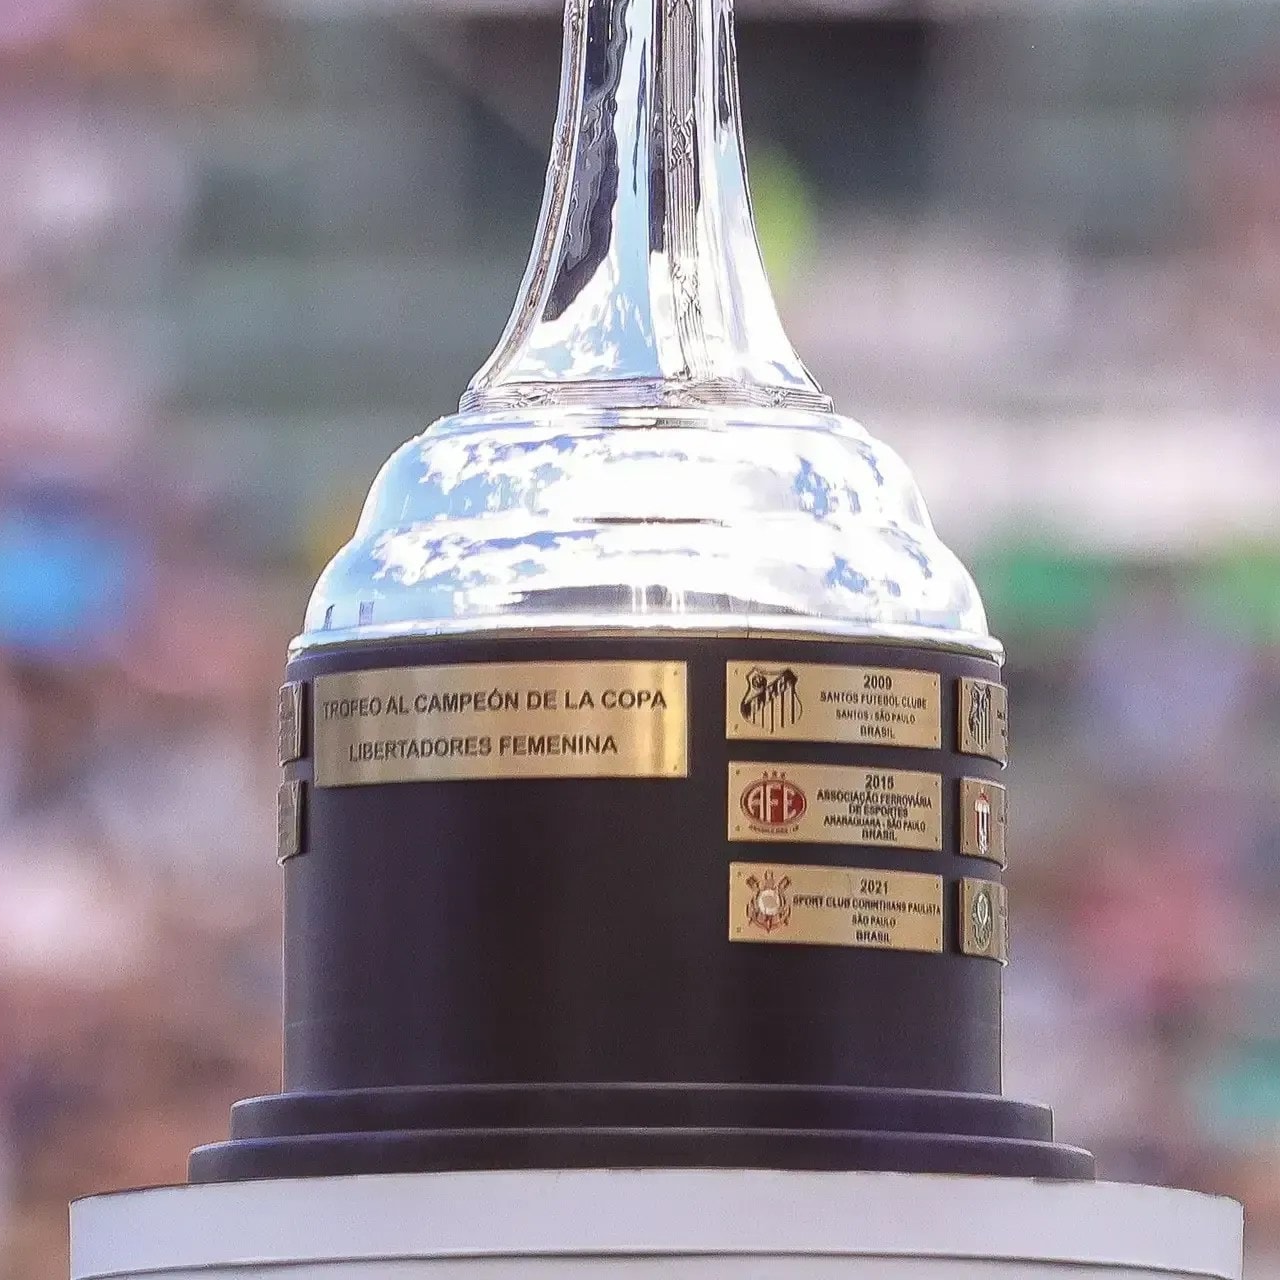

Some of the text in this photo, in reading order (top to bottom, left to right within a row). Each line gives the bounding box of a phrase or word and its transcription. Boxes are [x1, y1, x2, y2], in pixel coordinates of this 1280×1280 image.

[323, 687, 668, 720] TROFEO AL CAMPEÓN DE LA COPA
[820, 691, 927, 710] SANTOS FUTEBOL CLUBE
[835, 708, 869, 721] SANTOS
[891, 712, 916, 725] PAULO
[860, 725, 896, 739] BRASIL
[349, 734, 619, 763] LIBERTADORES FEMENINA
[860, 879, 888, 895] 2021
[825, 895, 851, 909] CLUB
